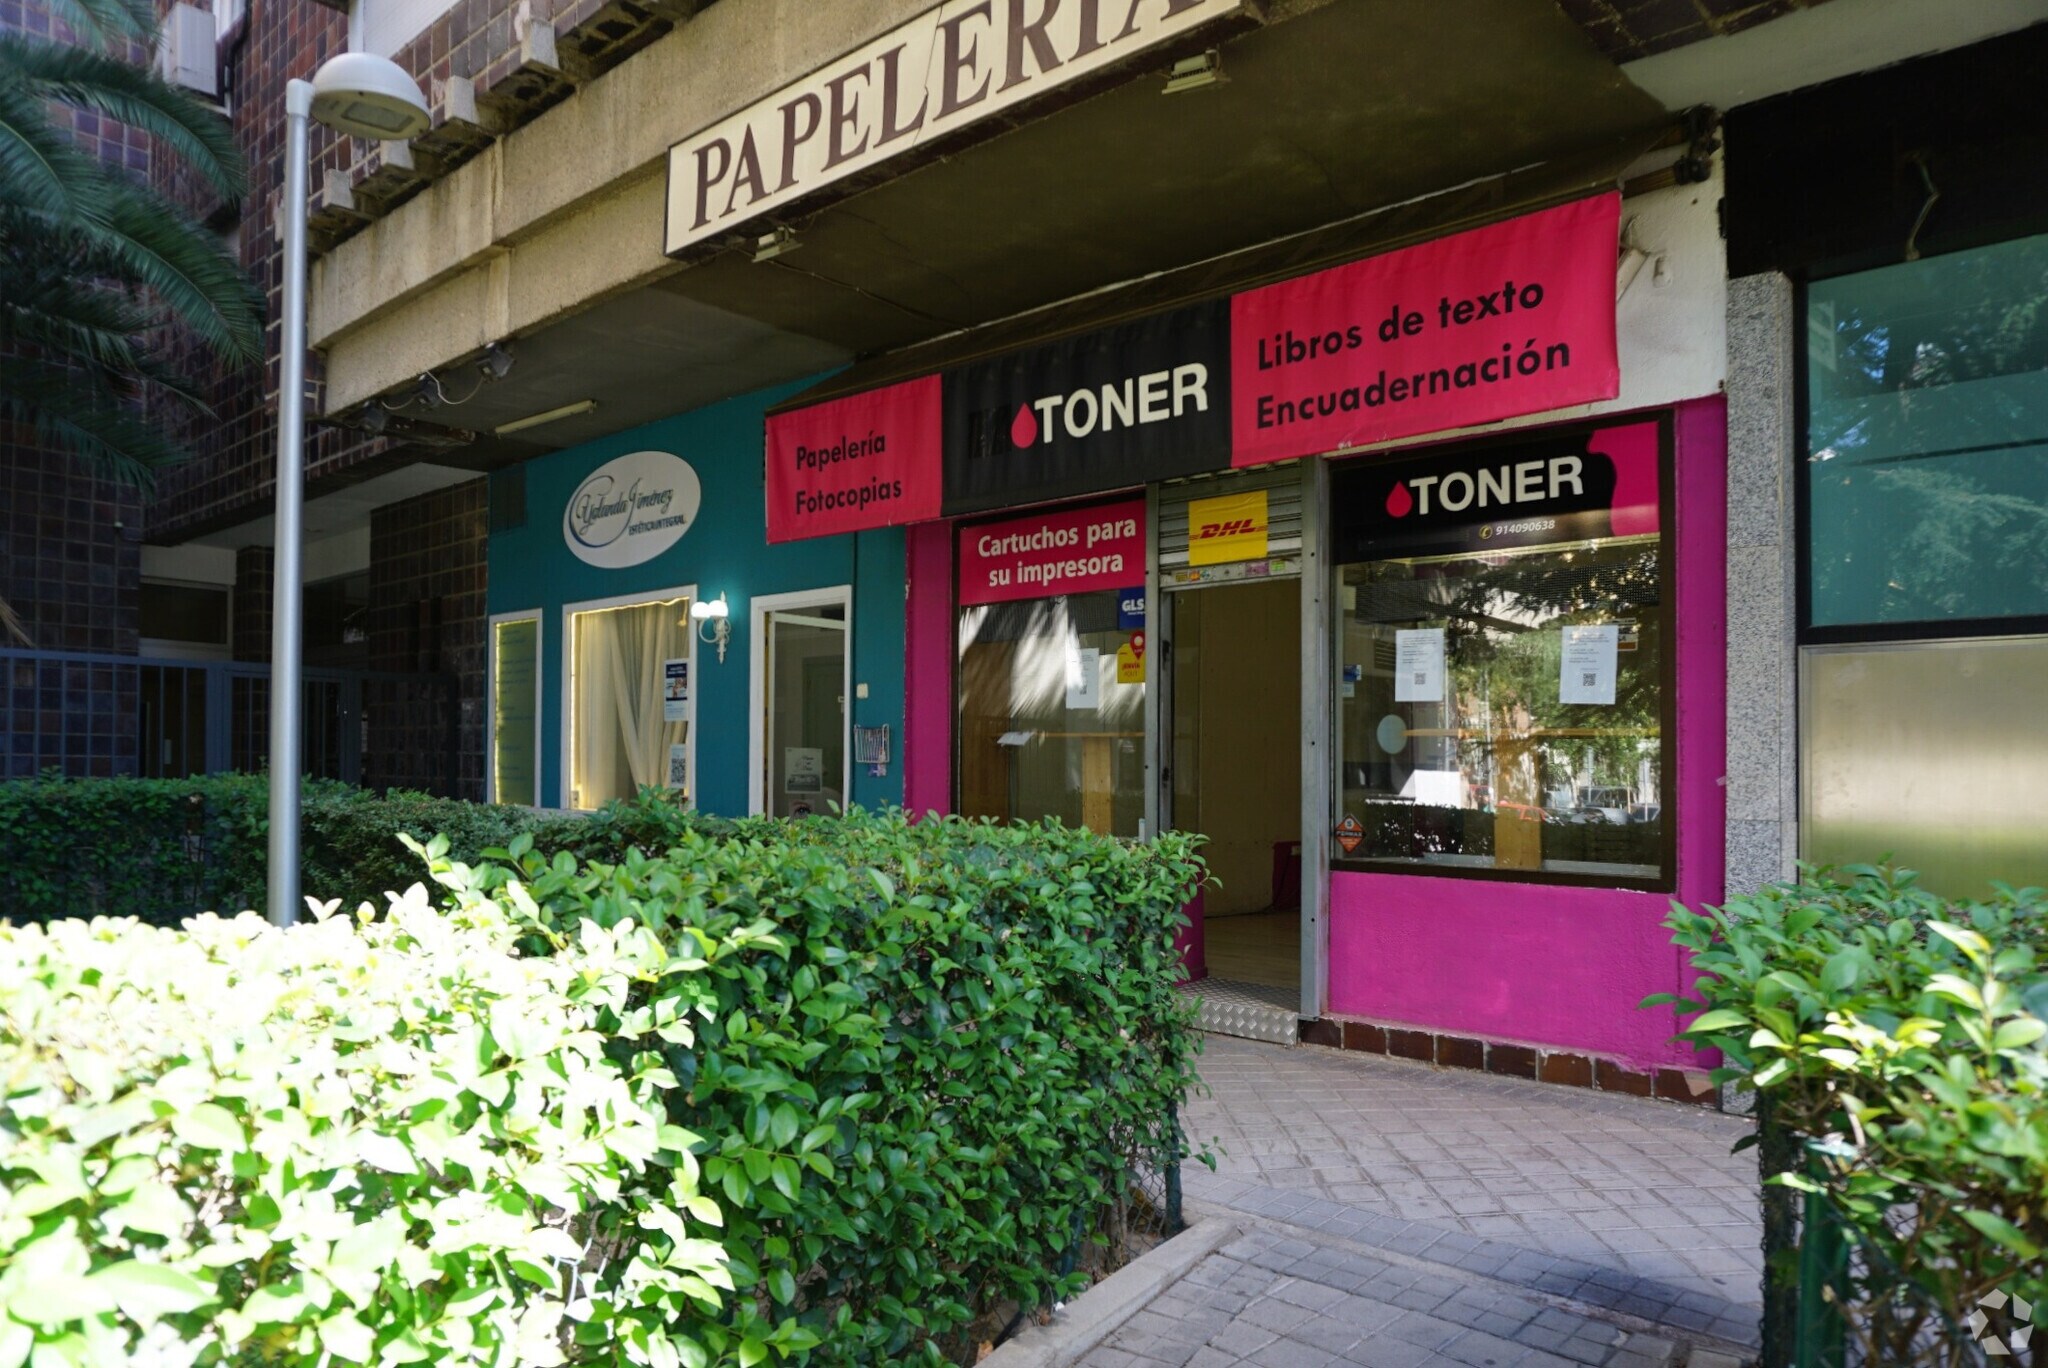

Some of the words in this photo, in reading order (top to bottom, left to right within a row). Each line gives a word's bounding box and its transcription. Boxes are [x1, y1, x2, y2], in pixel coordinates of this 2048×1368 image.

[1258, 325, 1363, 371] Libros
[1378, 304, 1425, 344] de
[1438, 280, 1545, 329] texto
[1034, 362, 1209, 444] TONER
[1257, 338, 1570, 430] Encuadernación
[796, 430, 886, 472] Papelería
[796, 476, 902, 515] Fotocopias
[1409, 455, 1584, 515] TONER
[977, 525, 1080, 558] Cartuchos
[1087, 518, 1137, 549] para
[1199, 518, 1256, 539] DHL
[1495, 520, 1556, 536] 914090638
[988, 567, 1011, 588] su
[1017, 553, 1124, 587] impresora
[1121, 598, 1145, 613] GLS
